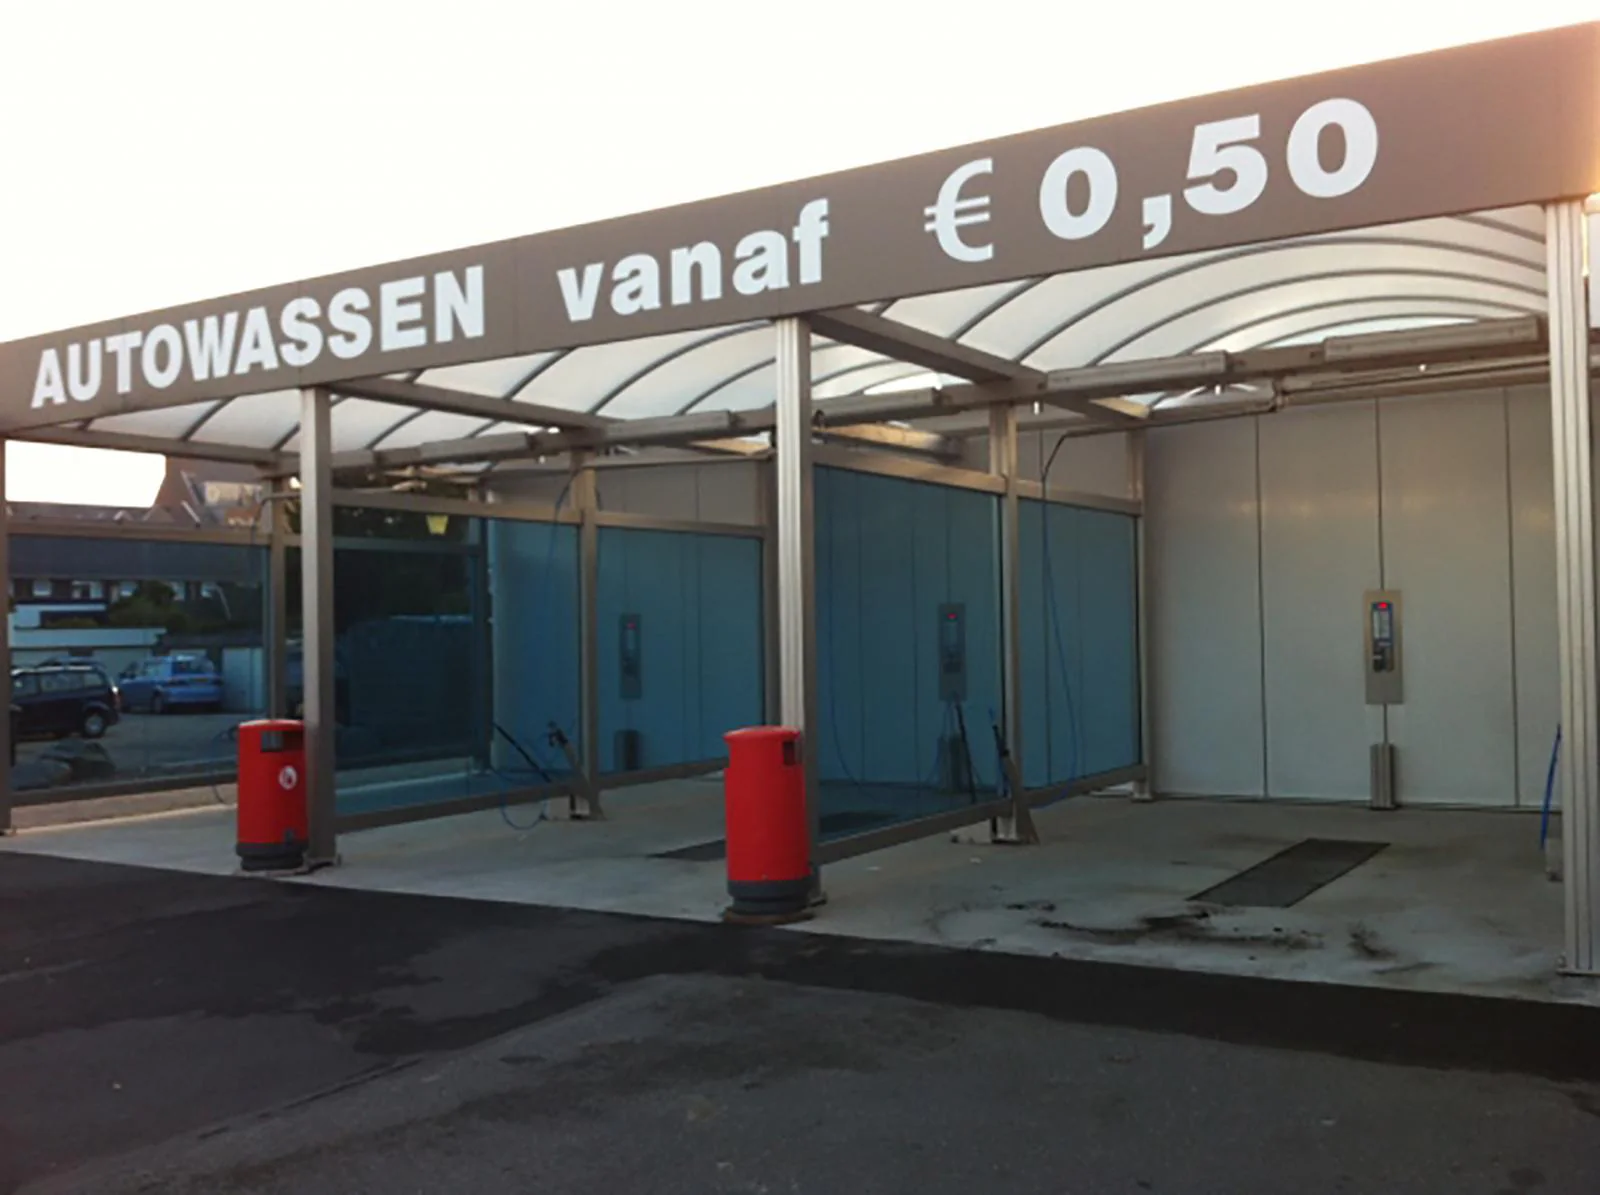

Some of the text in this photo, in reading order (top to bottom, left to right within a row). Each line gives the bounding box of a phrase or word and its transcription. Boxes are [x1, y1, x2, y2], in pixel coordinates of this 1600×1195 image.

[31, 98, 1378, 408] AUTOWASSEN vanaf € 0,50
